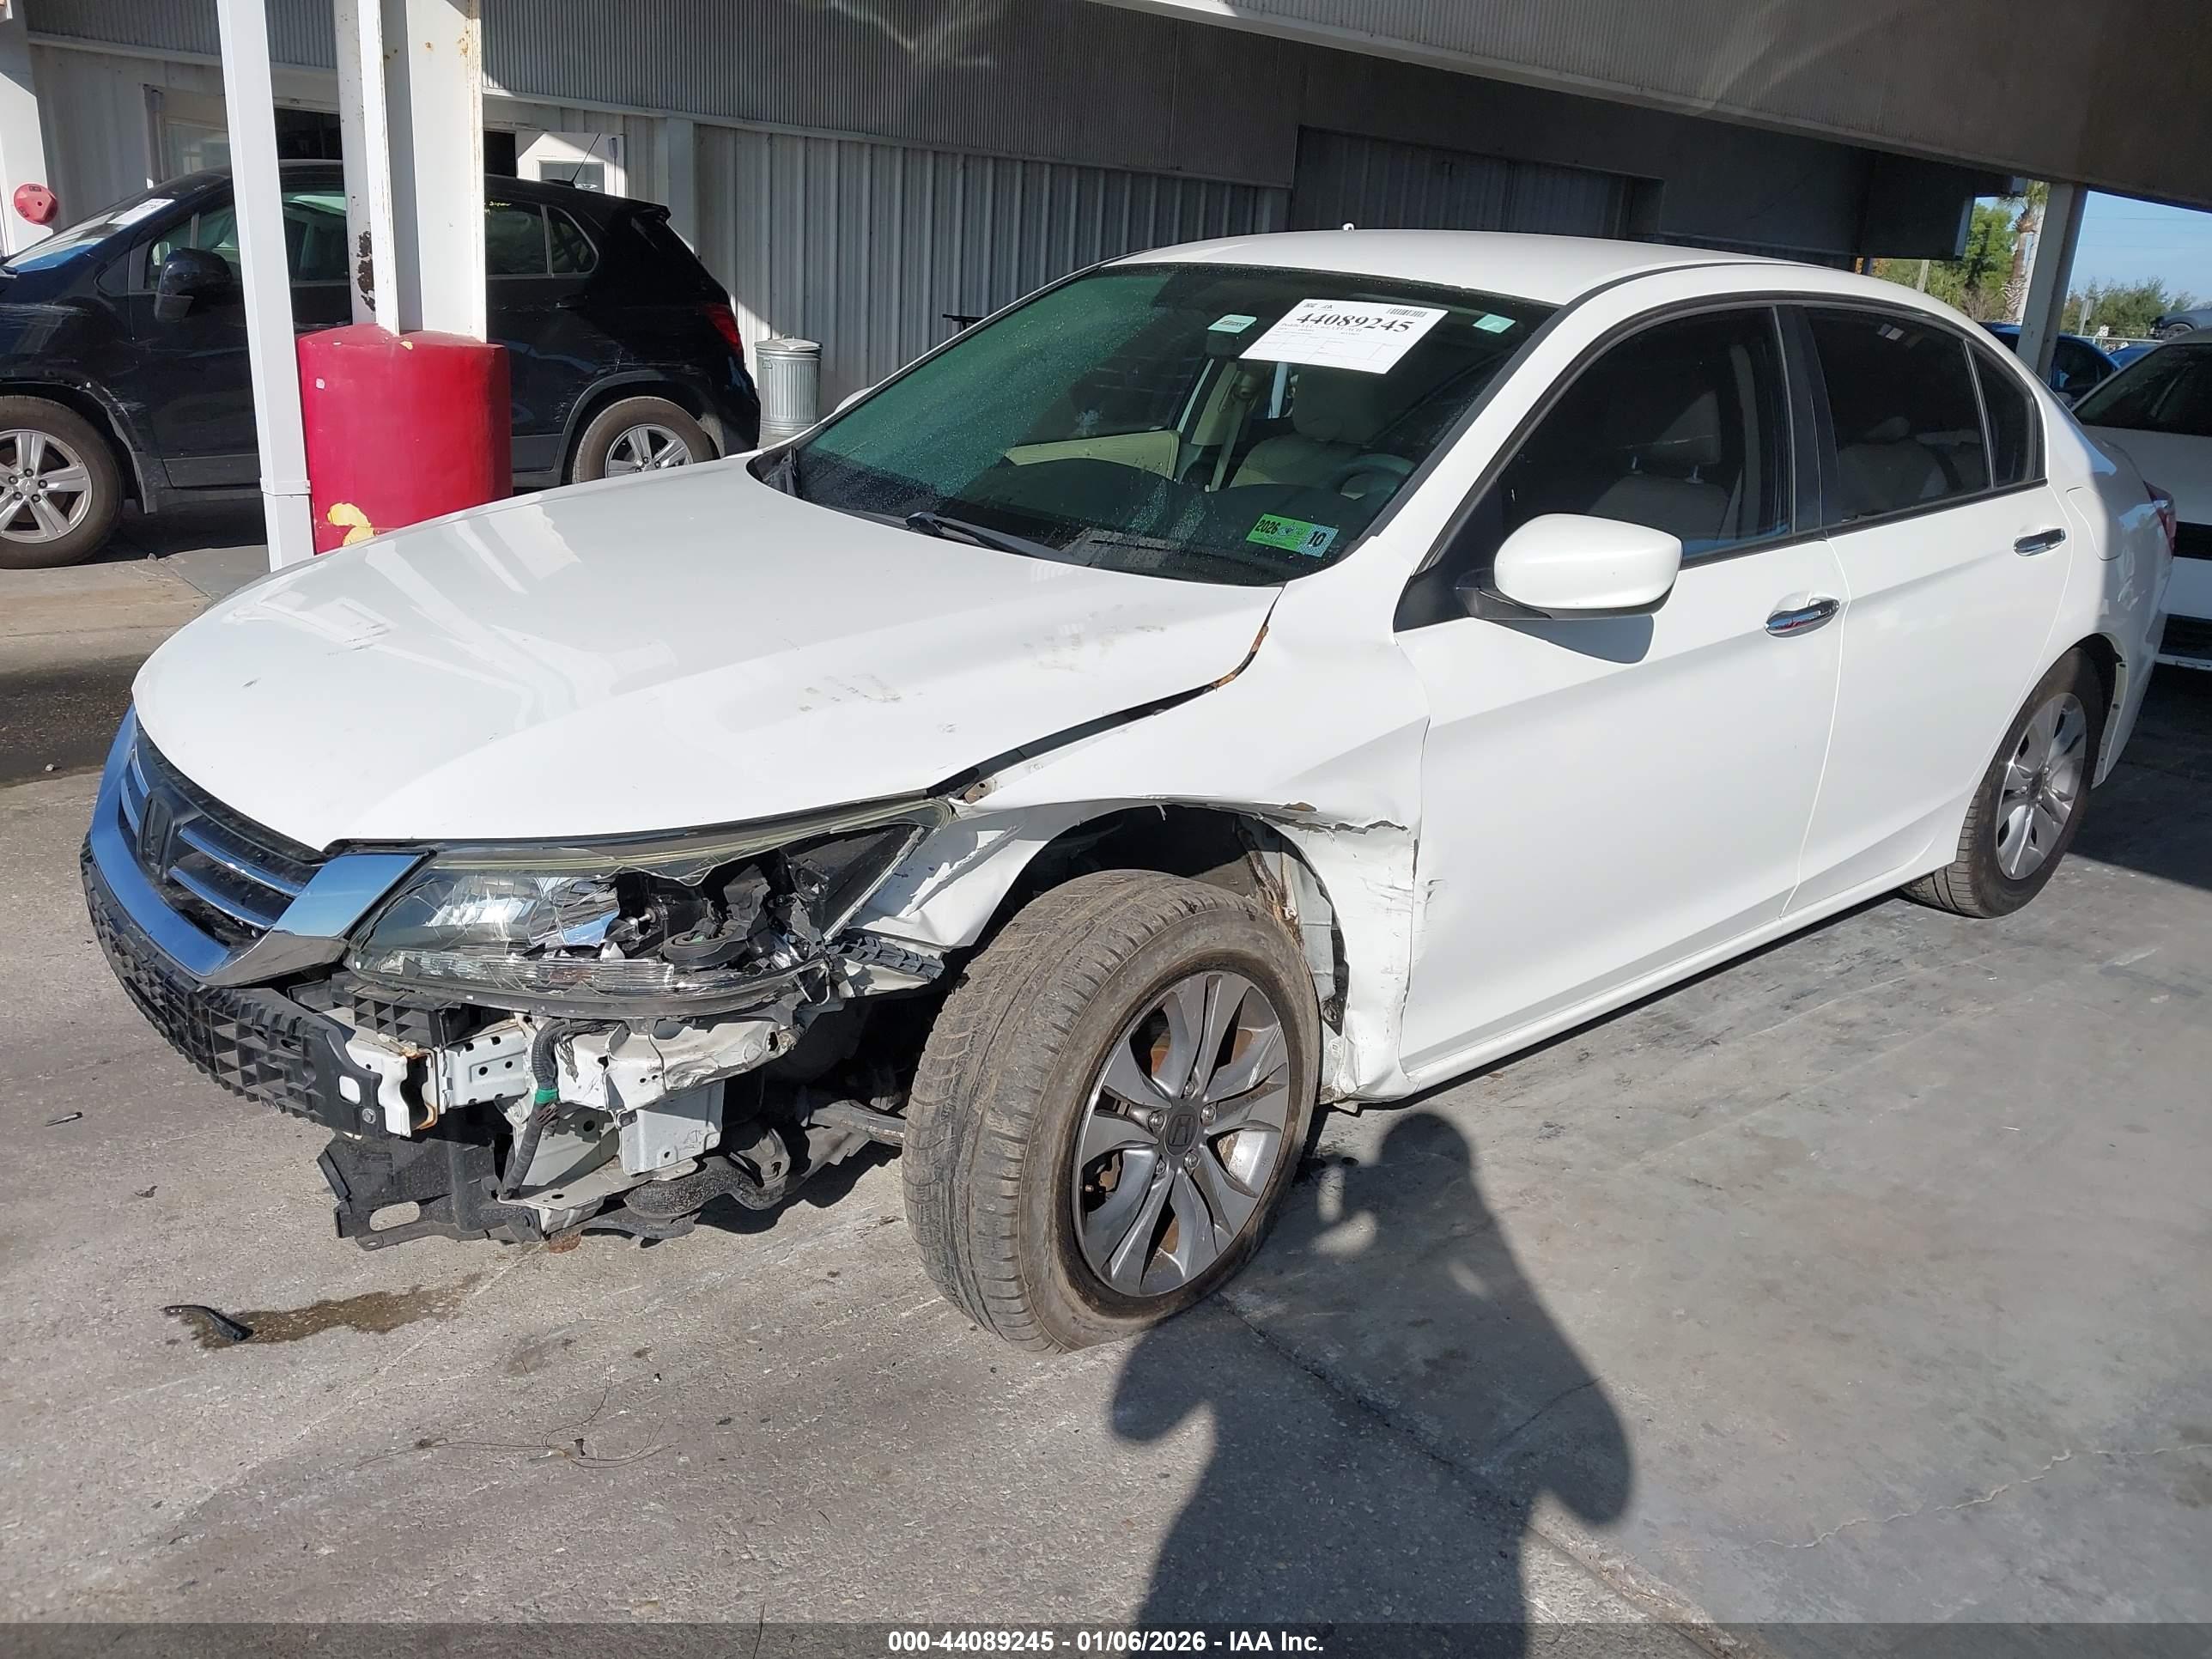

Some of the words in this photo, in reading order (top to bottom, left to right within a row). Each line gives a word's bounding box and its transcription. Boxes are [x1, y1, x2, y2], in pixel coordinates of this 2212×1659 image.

[1297, 313, 1414, 332] 44089245
[1255, 520, 1280, 534] 2026
[1310, 531, 1328, 547] 10
